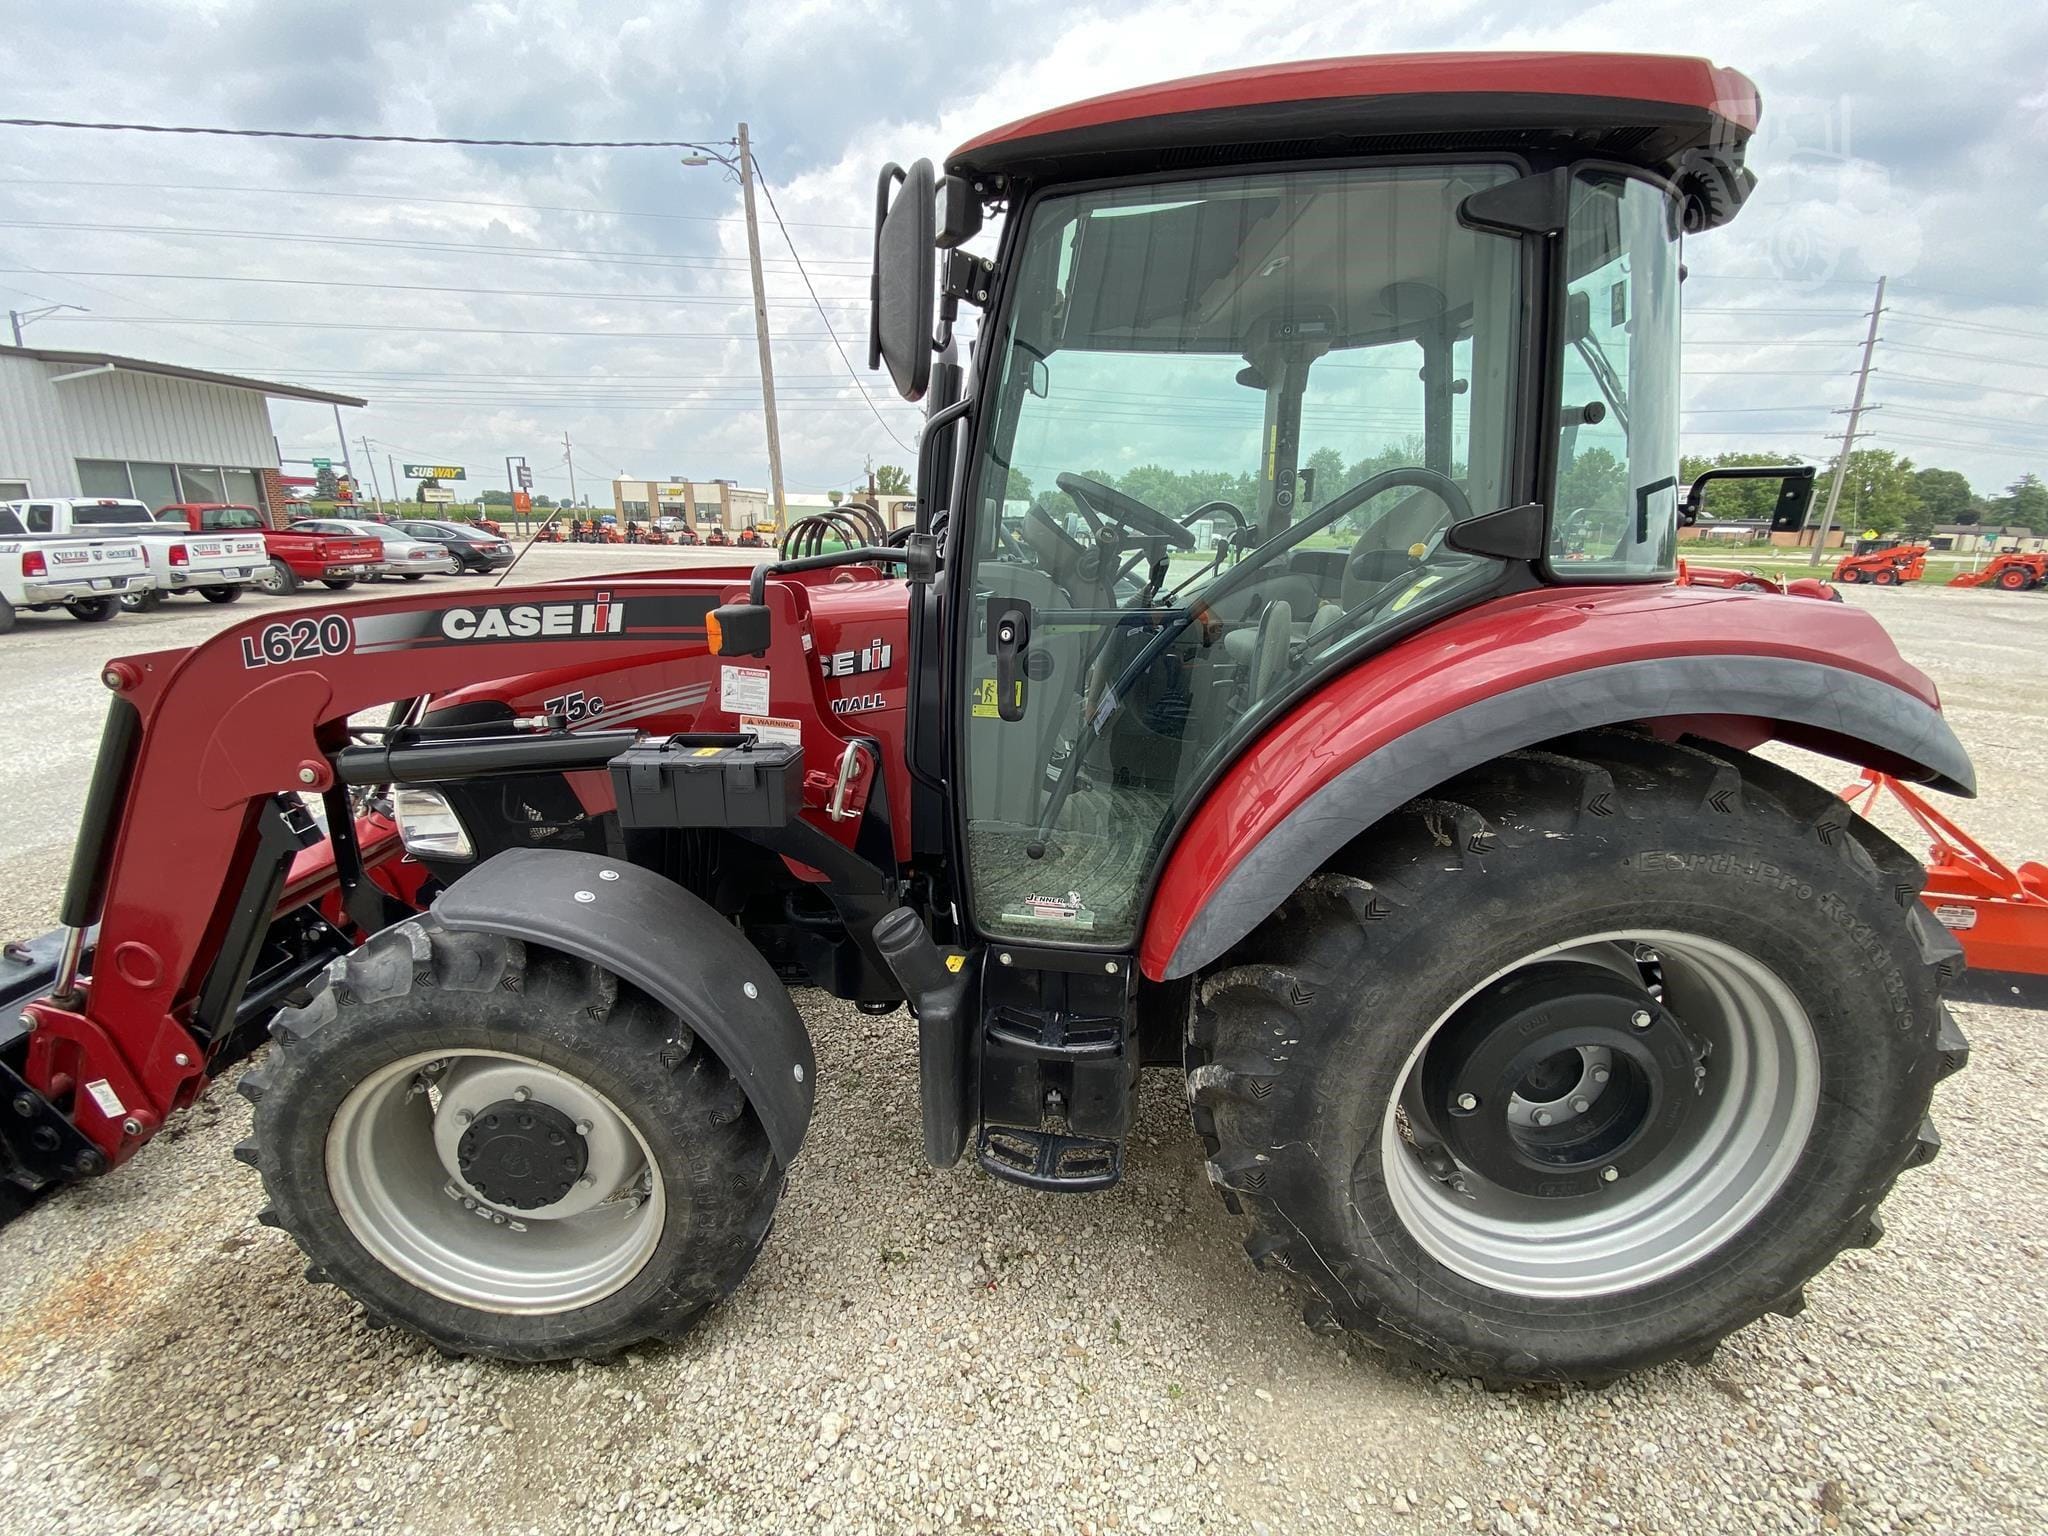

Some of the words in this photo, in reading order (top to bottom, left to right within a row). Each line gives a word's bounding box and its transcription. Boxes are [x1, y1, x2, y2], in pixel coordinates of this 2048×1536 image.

[409, 466, 462, 478] SUBWAY
[192, 543, 221, 557] SIEVERS
[331, 547, 379, 555] CHEVROLET
[52, 550, 88, 565] SIEVERS
[442, 605, 574, 640] CASE
[241, 614, 351, 669] L620
[746, 670, 766, 678] DANGER
[757, 719, 795, 728] WARNING
[1026, 893, 1065, 904] JENNER
[1638, 849, 1813, 901] Earth-Pro
[1822, 892, 1893, 970] Radial
[1883, 967, 1915, 1031] 850
